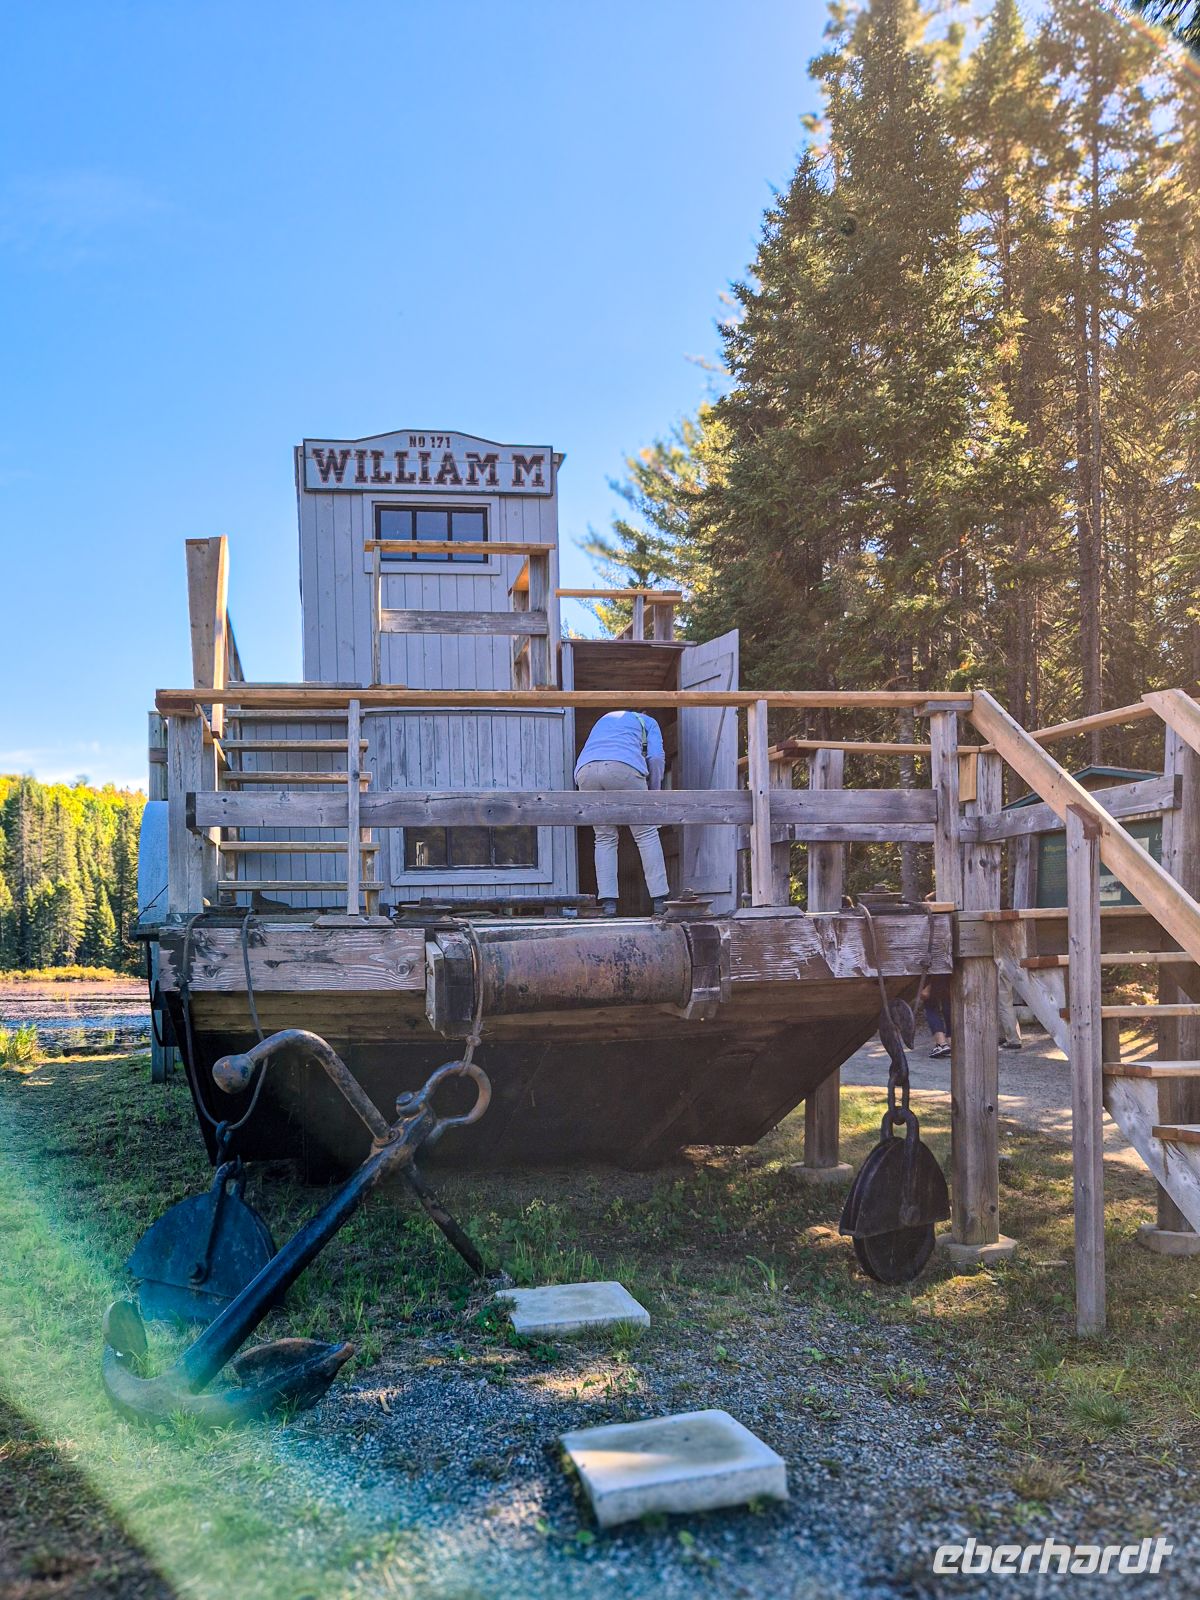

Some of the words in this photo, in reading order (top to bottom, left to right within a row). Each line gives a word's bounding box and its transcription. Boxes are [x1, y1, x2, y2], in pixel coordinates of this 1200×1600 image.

[409, 436, 425, 447] NO
[430, 436, 450, 448] 171
[311, 447, 499, 486] WILLIAM
[512, 453, 545, 487] M
